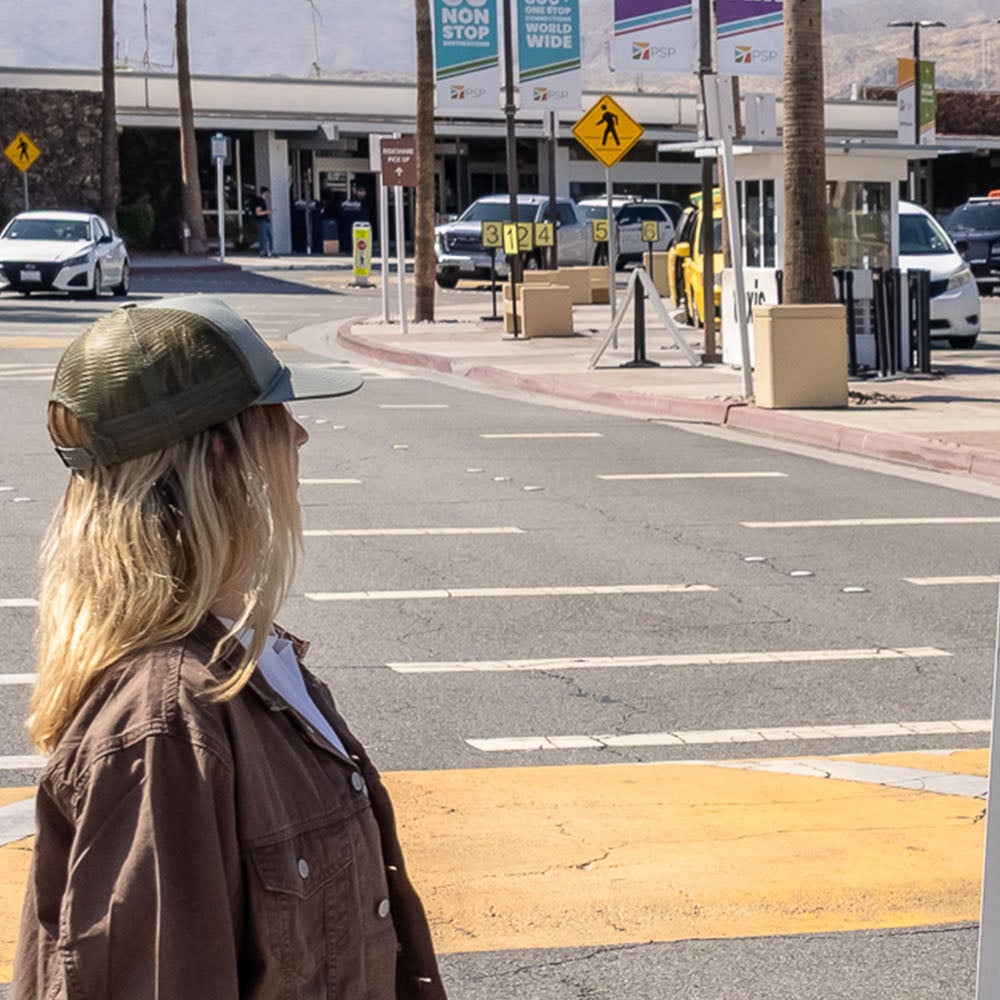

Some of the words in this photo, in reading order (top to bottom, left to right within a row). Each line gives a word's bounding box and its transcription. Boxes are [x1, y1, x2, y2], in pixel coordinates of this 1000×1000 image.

[442, 8, 489, 24] NON
[525, 6, 545, 14] ONE
[547, 6, 571, 15] STOP
[442, 25, 490, 40] STOP
[526, 23, 572, 33] WORLD
[526, 34, 573, 48] WIDE
[651, 46, 677, 58] PSP
[752, 50, 779, 62] PSP
[465, 87, 487, 98] PSP
[548, 89, 569, 98] PSP
[486, 224, 499, 244] 3
[518, 226, 529, 247] 2
[538, 226, 550, 243] 4
[596, 221, 608, 240] 5
[645, 223, 656, 240] 6
[507, 228, 514, 250] 1
